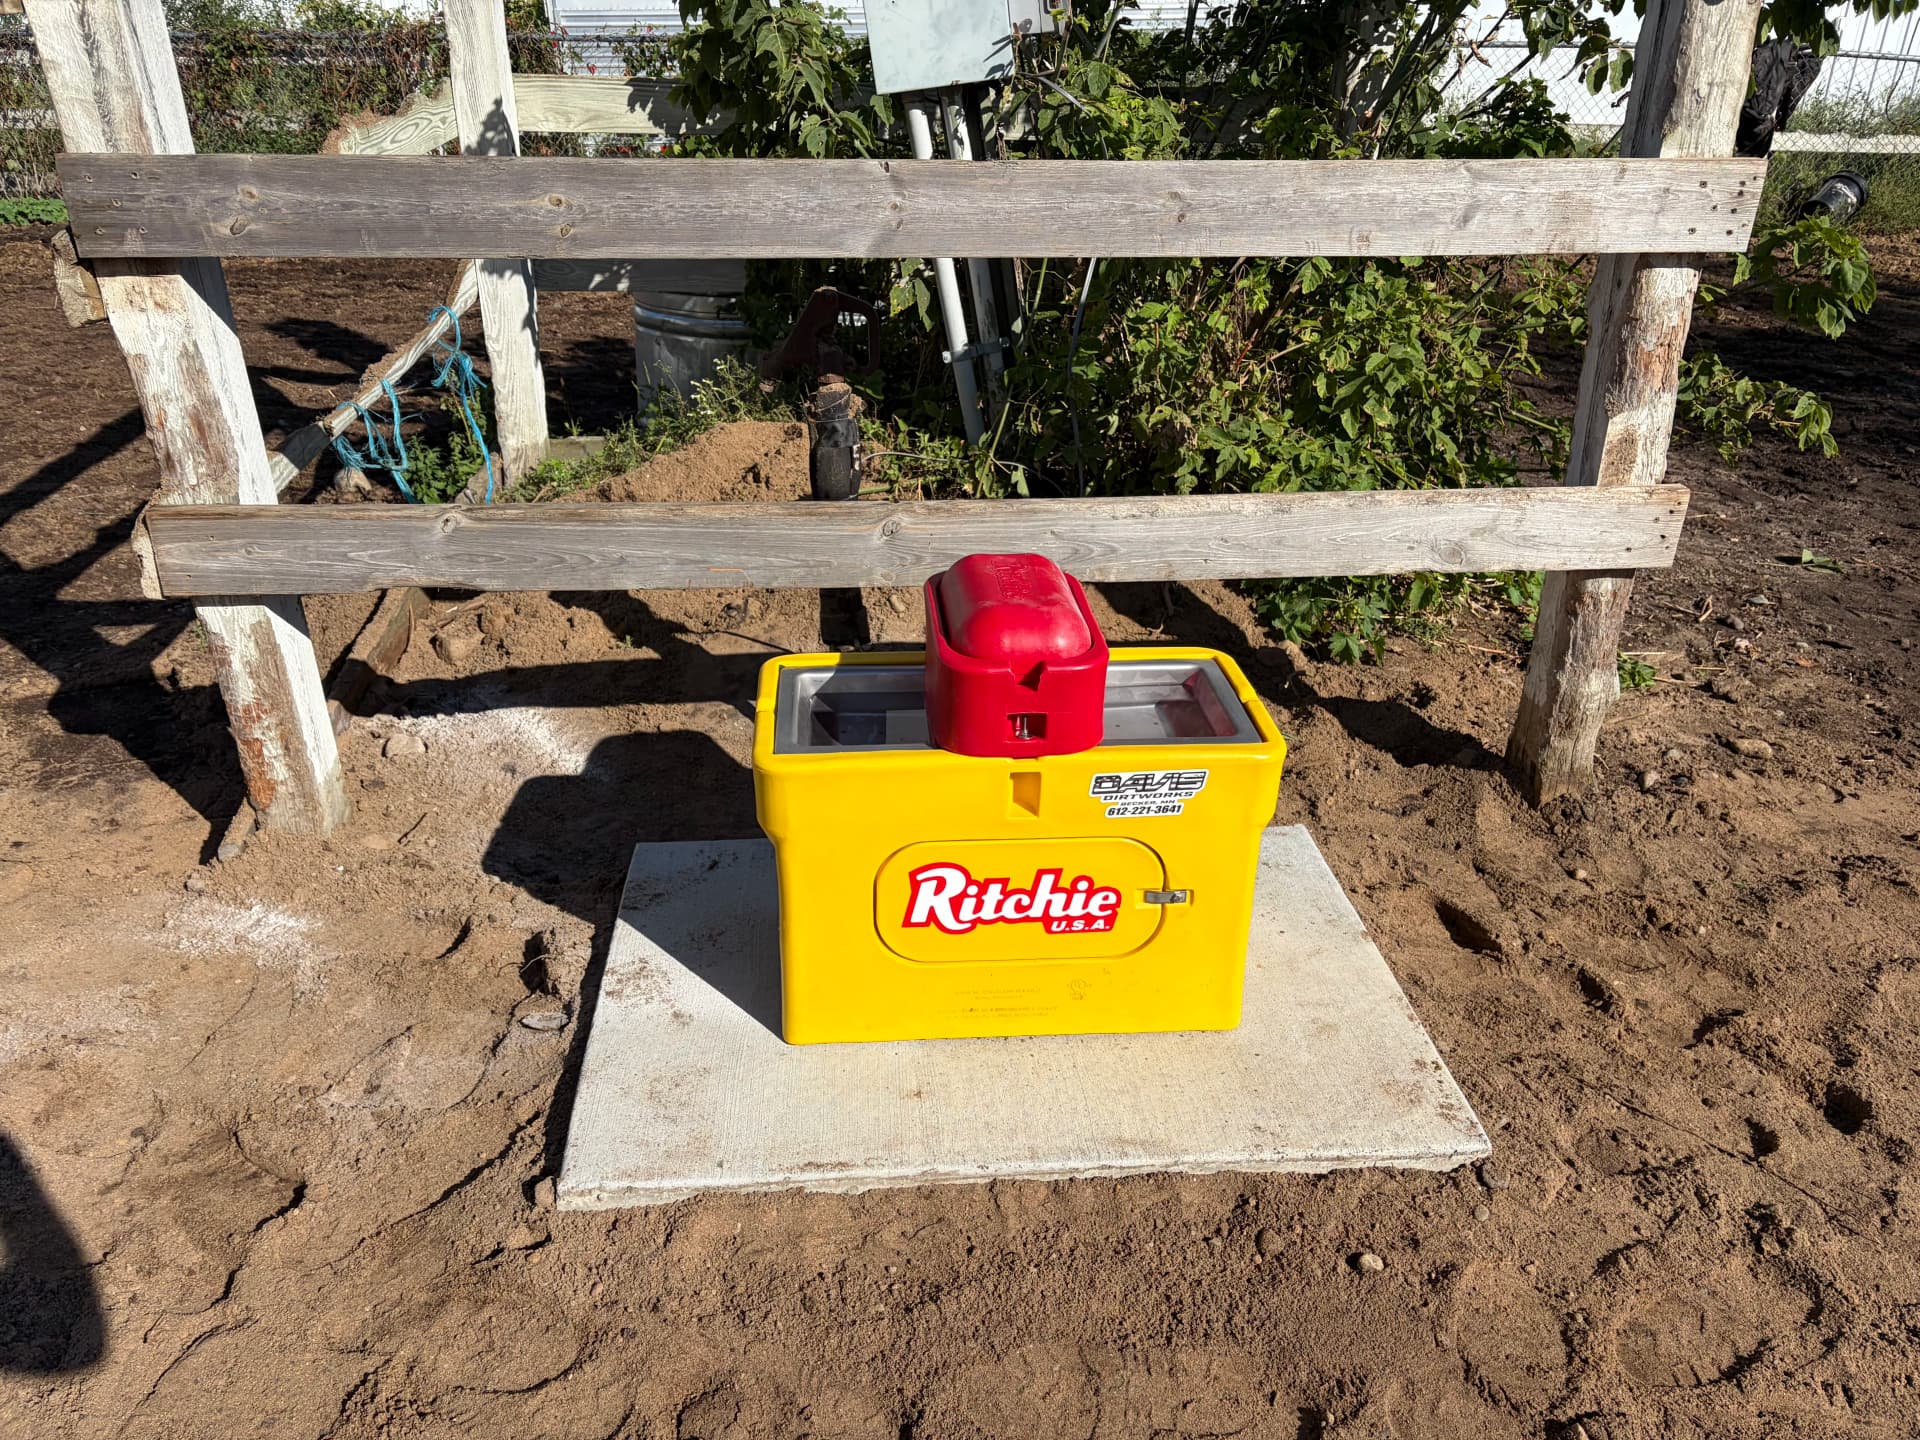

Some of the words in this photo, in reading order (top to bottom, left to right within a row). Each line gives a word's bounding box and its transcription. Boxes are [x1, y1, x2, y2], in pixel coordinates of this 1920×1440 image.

[1092, 771, 1207, 795] DAVIS
[1103, 791, 1194, 801] DIRTWORKS
[1107, 804, 1182, 816] 612-221-3641
[909, 866, 1119, 931] Ritchie
[1051, 919, 1111, 932] U.S.A.
